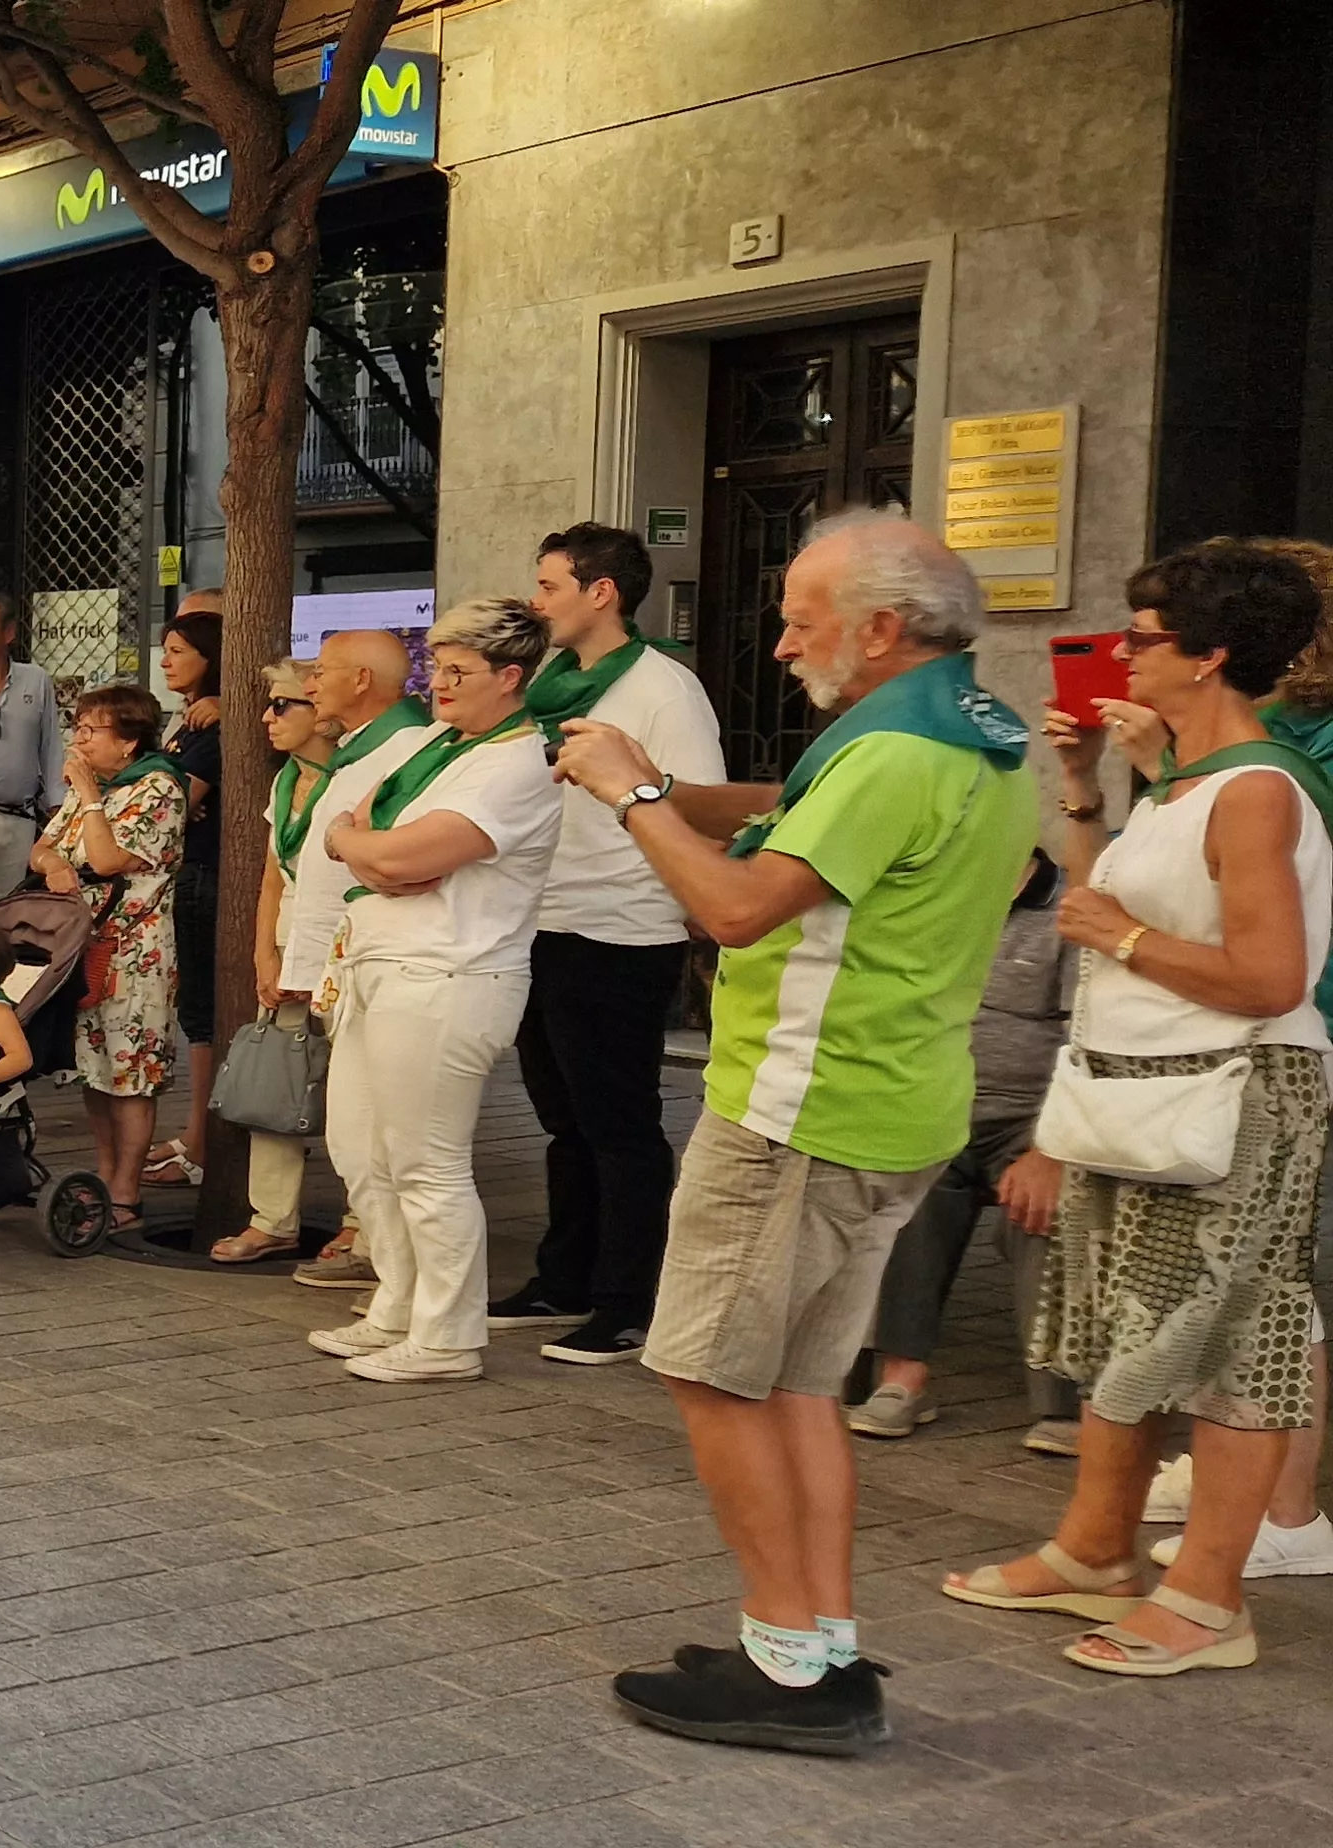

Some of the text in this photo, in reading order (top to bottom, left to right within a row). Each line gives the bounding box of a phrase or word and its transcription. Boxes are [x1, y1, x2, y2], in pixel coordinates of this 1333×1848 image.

[358, 127, 419, 146] movistar
[39, 619, 106, 639] Hat trick
